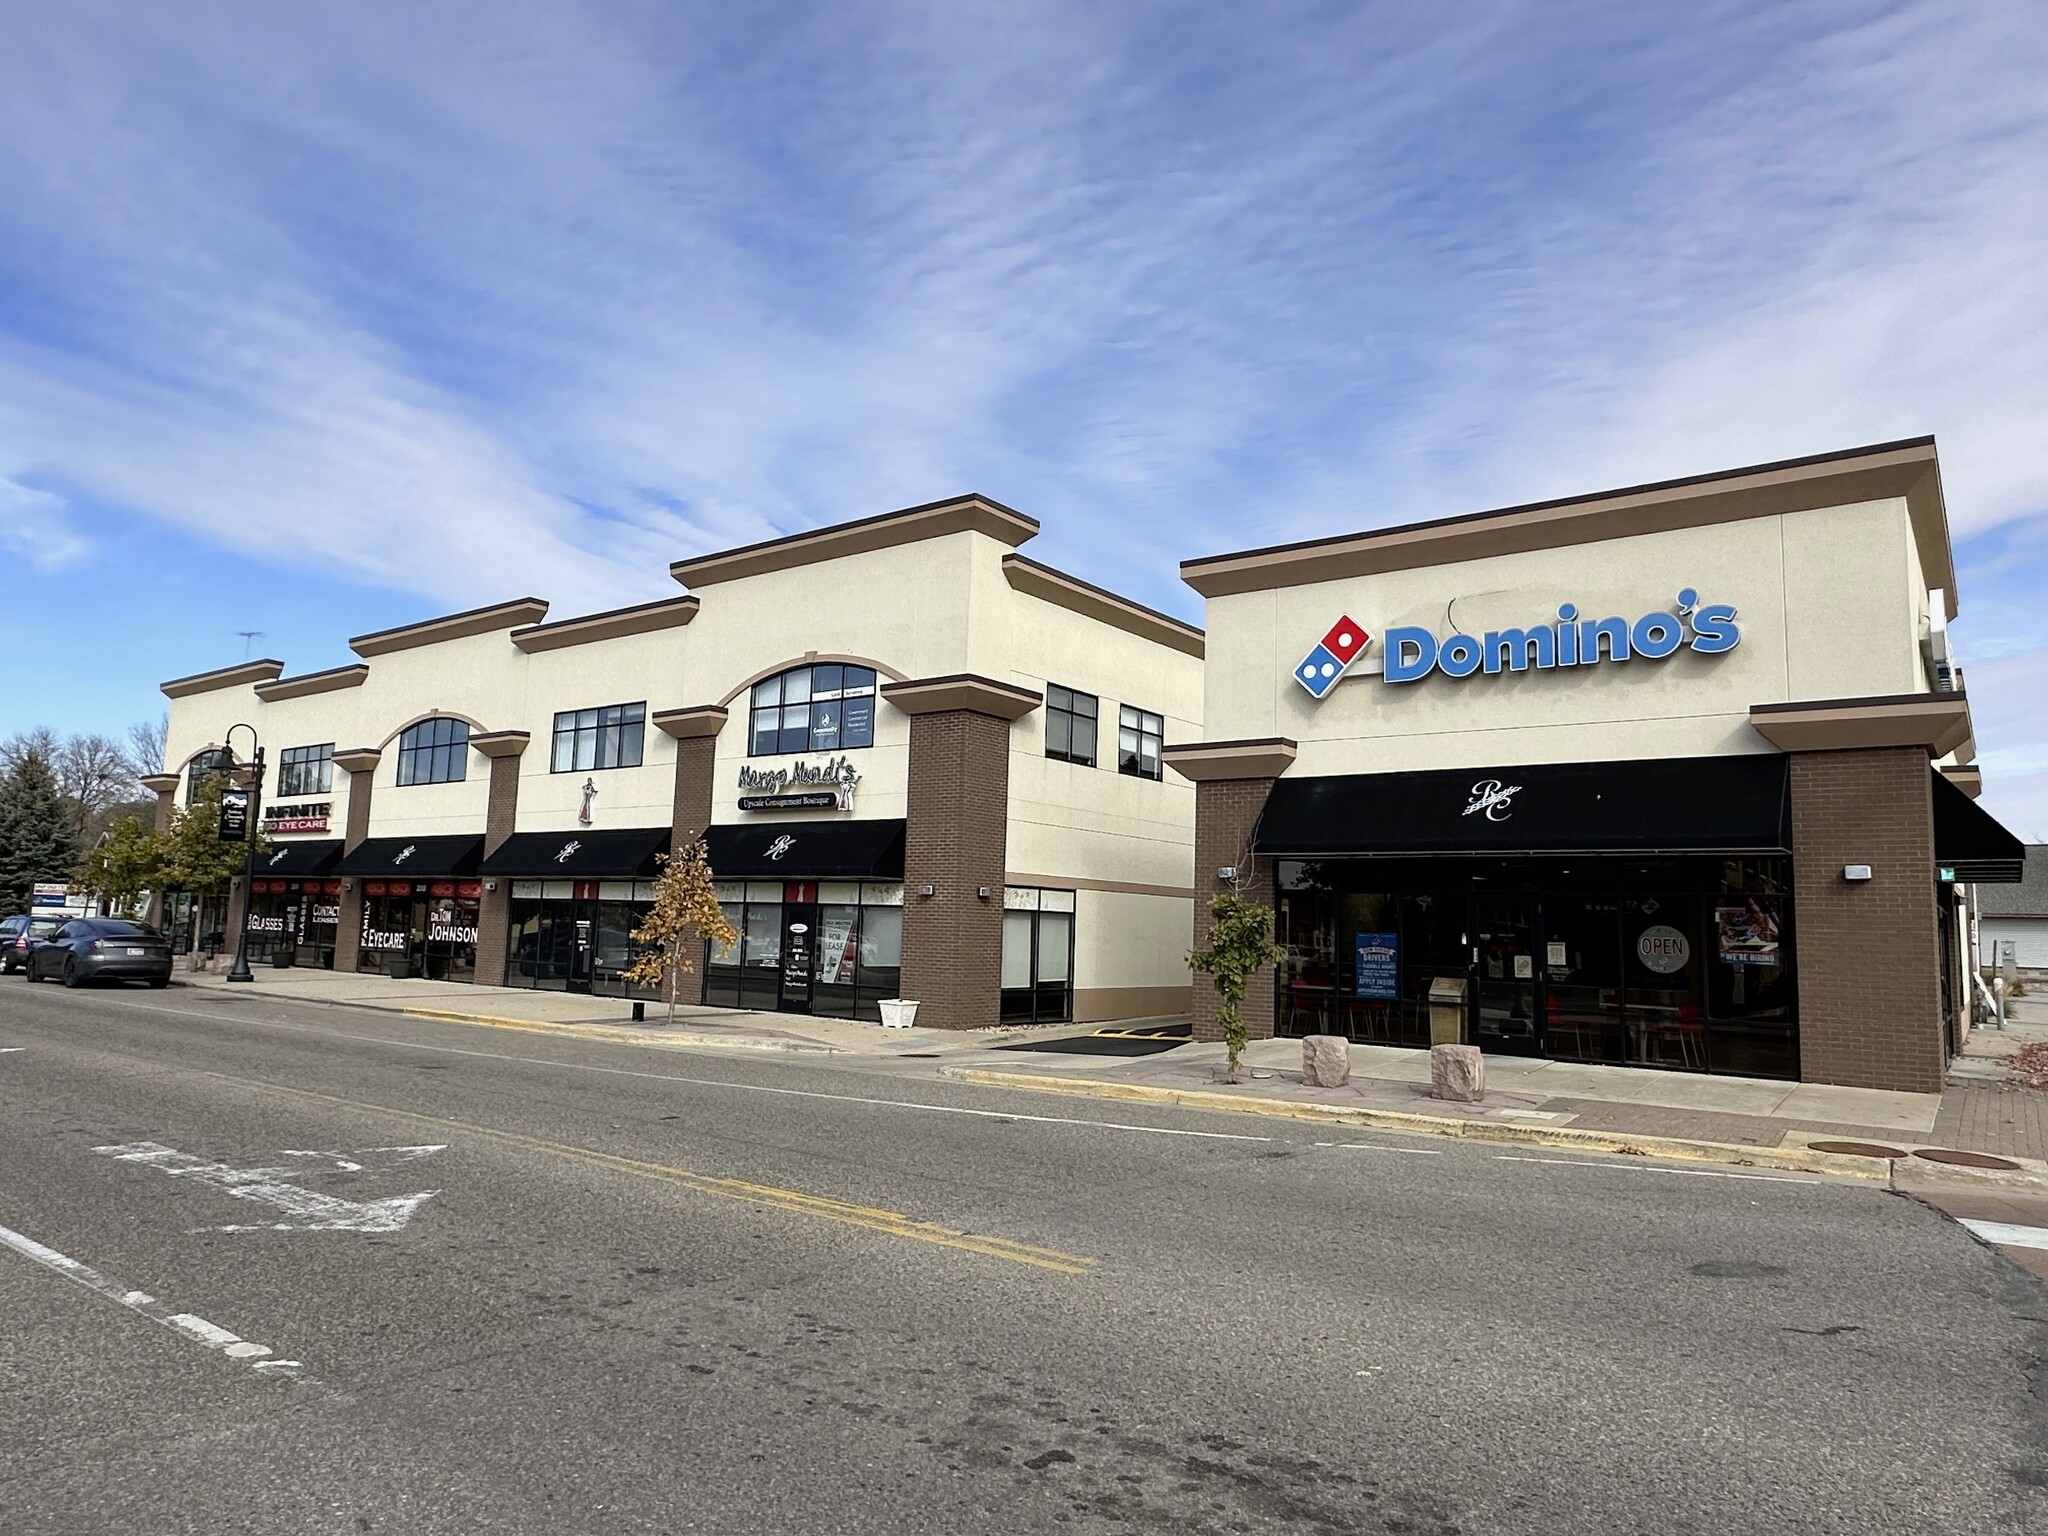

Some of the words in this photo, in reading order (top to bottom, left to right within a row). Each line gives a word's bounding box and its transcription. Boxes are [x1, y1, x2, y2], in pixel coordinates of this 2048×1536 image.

[1383, 587, 1741, 683] Domino's
[738, 765, 787, 795] Margo
[743, 799, 765, 808] Upscale
[765, 797, 802, 808] Consignment
[803, 795, 830, 806] Boutique
[265, 802, 331, 819] INFINITE
[278, 821, 297, 830] EYE
[298, 820, 326, 829] CARE
[312, 904, 340, 916] CONTACT
[252, 914, 283, 931] GLASSES
[360, 900, 371, 947] FAMILY
[368, 929, 405, 949] EYECARE
[428, 923, 479, 943] JOHNSON
[826, 942, 844, 951] LEASE
[1641, 937, 1683, 956] OPEN
[1363, 954, 1391, 962] DRIVERS
[1726, 952, 1749, 961] WE'RE
[1750, 954, 1775, 962] HIRING
[1359, 977, 1376, 985] APPLY
[1376, 978, 1396, 986] INSIDE
